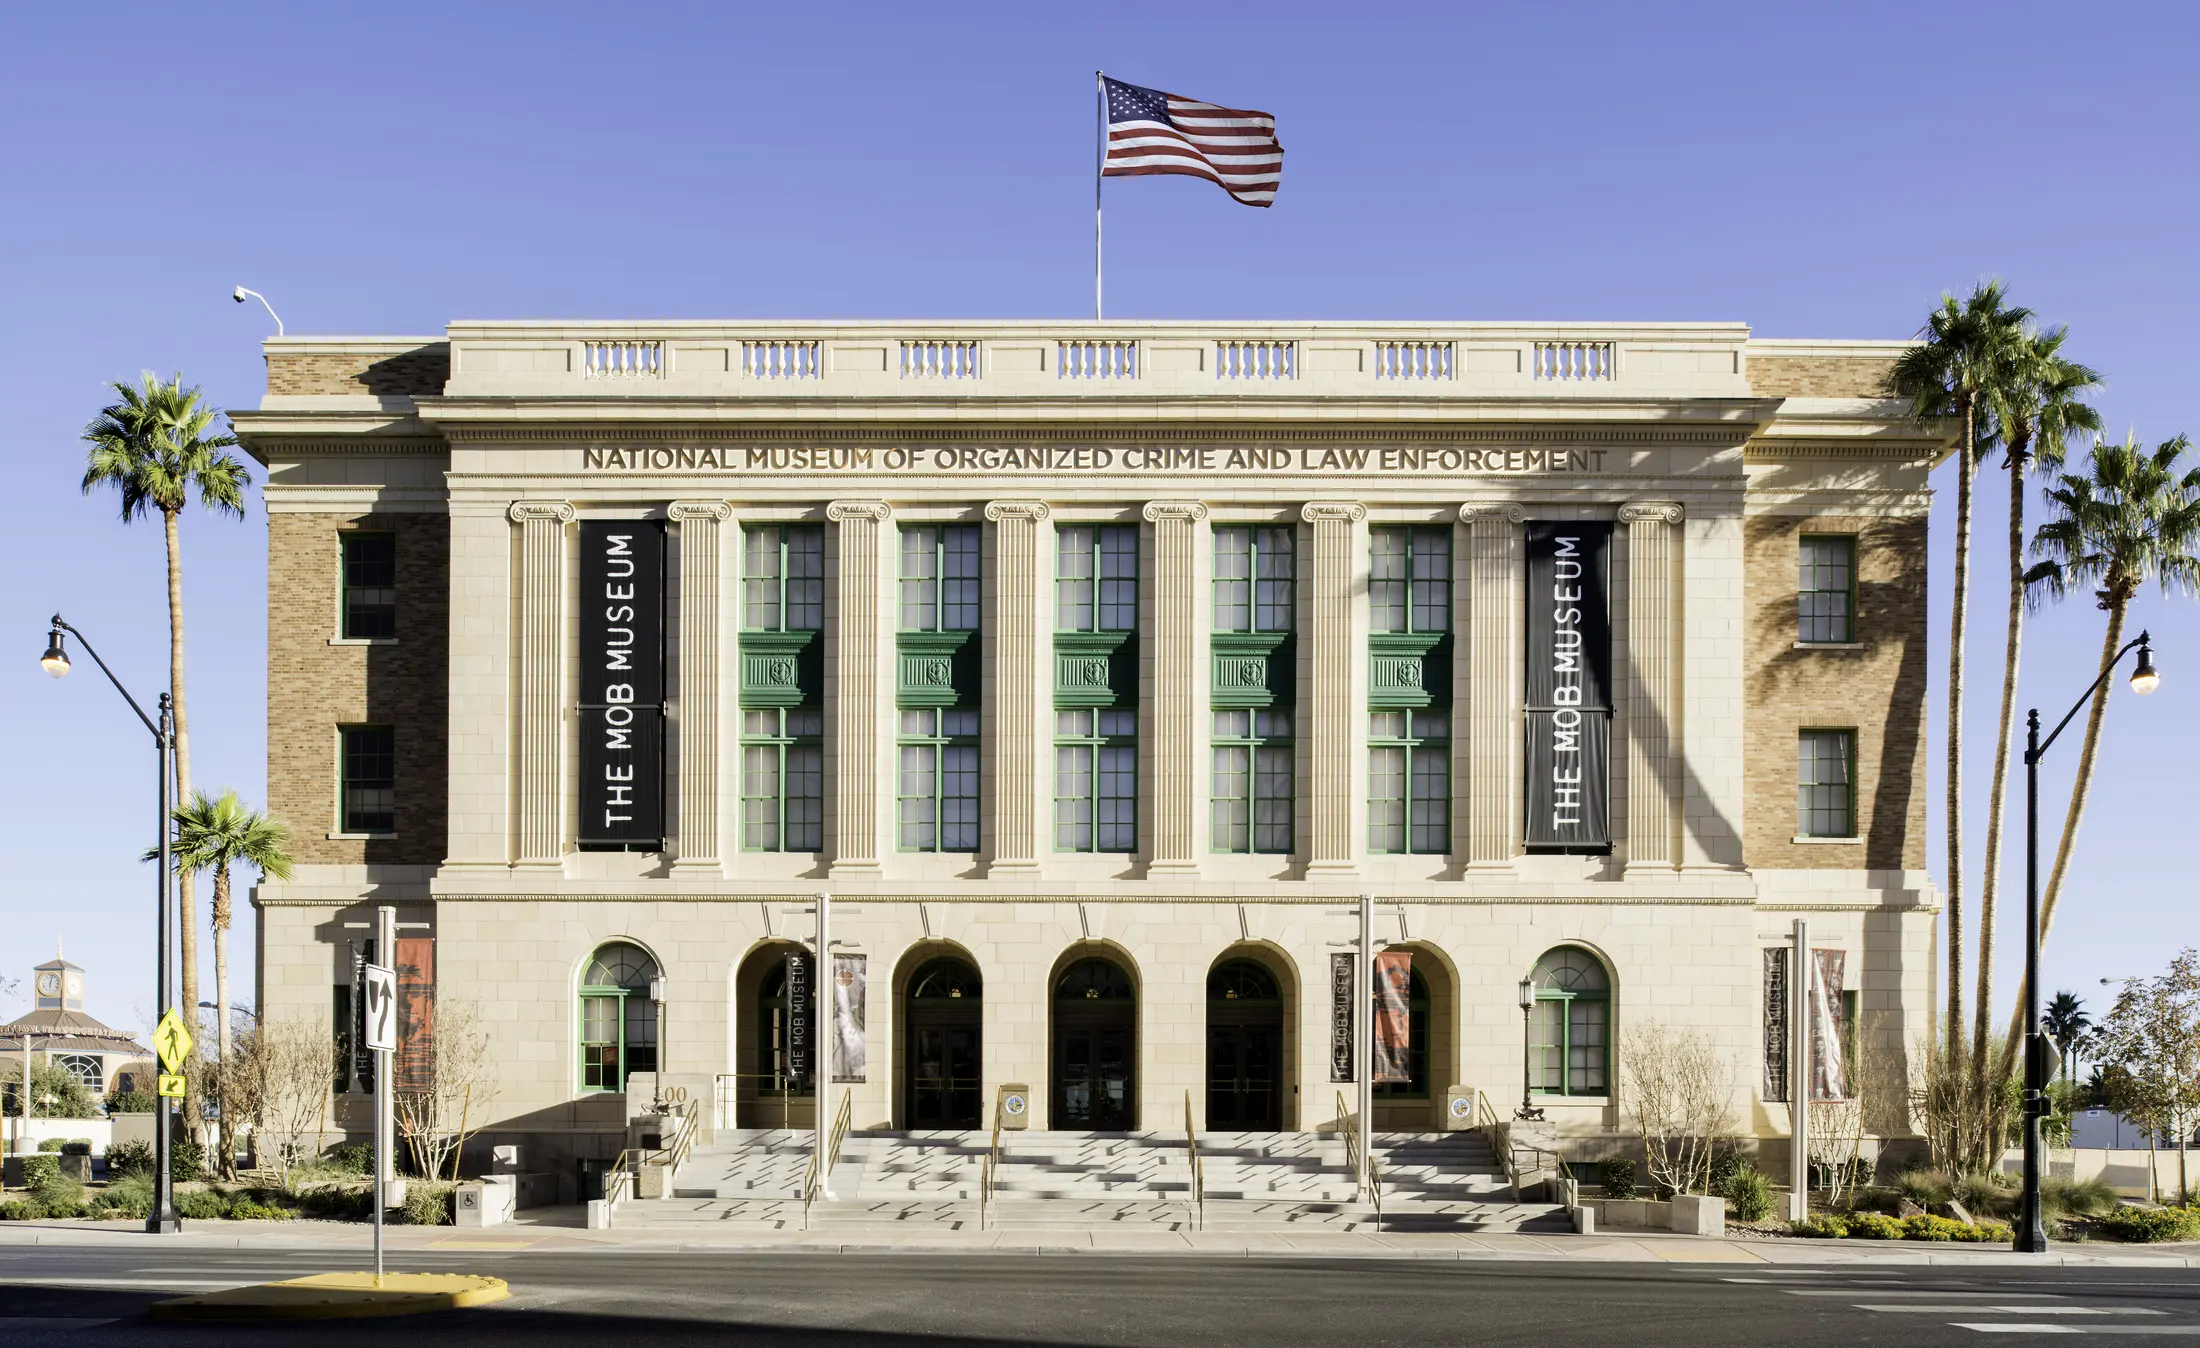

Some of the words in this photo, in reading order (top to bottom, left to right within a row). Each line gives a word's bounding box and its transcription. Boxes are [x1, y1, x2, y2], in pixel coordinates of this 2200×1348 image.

[583, 447, 736, 470] NATIONAL
[745, 447, 873, 470] MUSEUM
[882, 447, 926, 470] OF
[933, 447, 1115, 471] ORGANIZED
[1121, 448, 1215, 471] CRIME
[1224, 448, 1292, 471] AND
[1300, 448, 1370, 471] LAW
[1378, 448, 1608, 472] ENFORCEMENT
[605, 534, 634, 670] MUSEUM
[1553, 537, 1582, 672] MUSEUM
[605, 683, 634, 749] MOB
[1553, 685, 1582, 751] MOB
[605, 763, 633, 828] THE
[1553, 766, 1581, 831] THE
[792, 956, 805, 1013] MUSEUM
[1336, 957, 1348, 1014] MUSEUM
[1769, 962, 1782, 1020] MUSEUM
[792, 1017, 805, 1045] MOB
[1336, 1019, 1348, 1046] MOB
[1769, 1026, 1782, 1054] MOB
[356, 1051, 368, 1078] THE
[792, 1050, 804, 1076] THE
[1336, 1051, 1348, 1077] THE
[1769, 1059, 1782, 1086] THE
